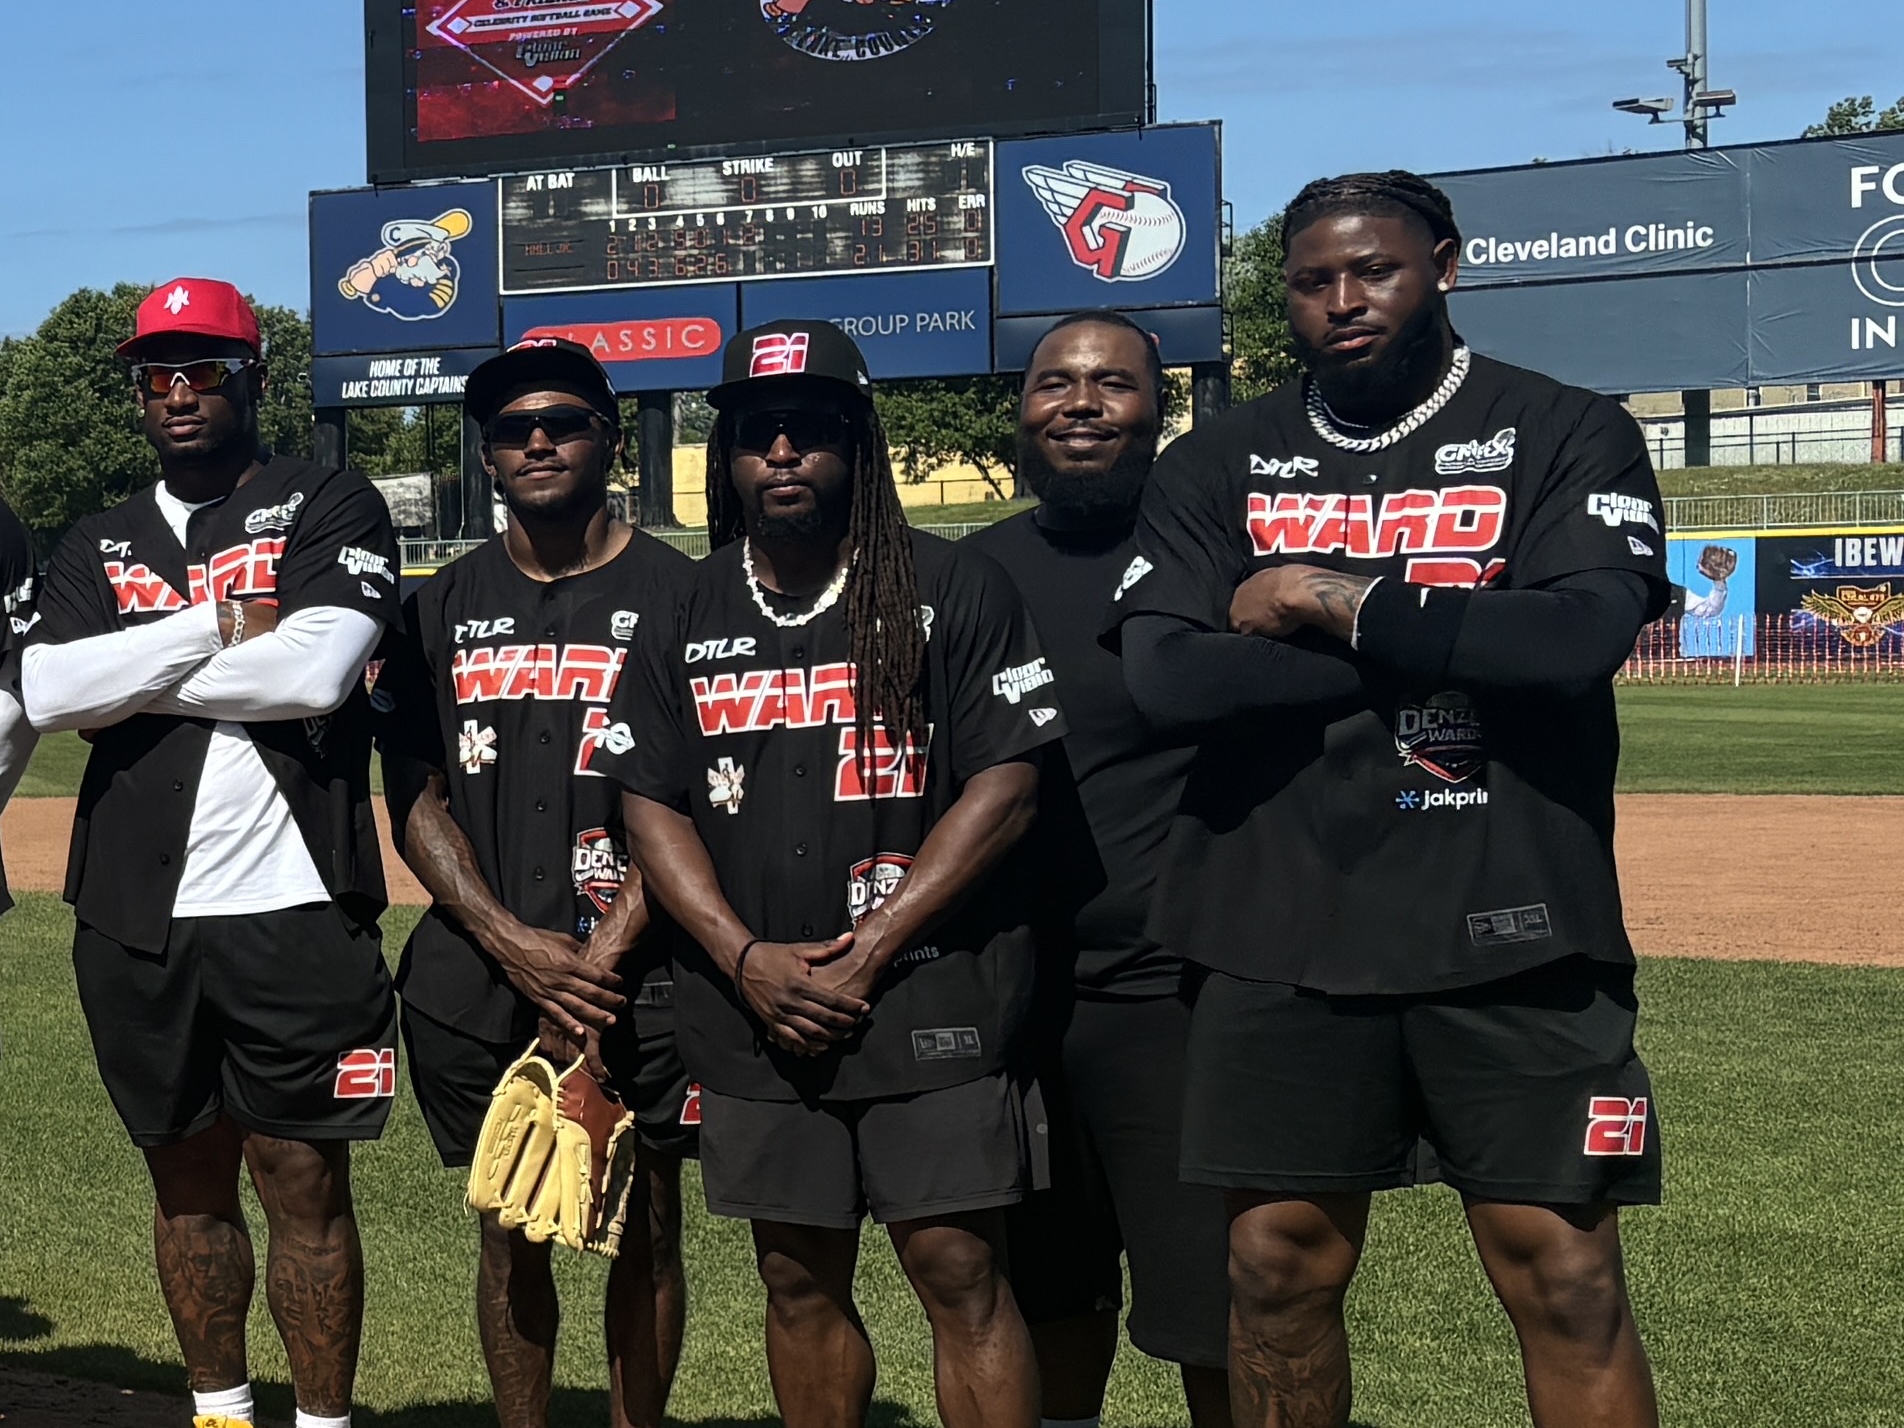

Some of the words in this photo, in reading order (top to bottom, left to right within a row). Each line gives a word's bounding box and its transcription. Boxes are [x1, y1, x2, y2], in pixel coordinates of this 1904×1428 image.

[951, 141, 976, 157] H/E
[526, 175, 544, 191] AT
[547, 172, 576, 189] BAT
[632, 165, 671, 183] BALL
[723, 157, 774, 176] STRIKE
[832, 150, 864, 168] OUT
[644, 184, 659, 209] 0
[742, 176, 757, 202] 0
[840, 168, 856, 195] 0
[609, 220, 616, 232] 1
[628, 218, 637, 231] 2
[648, 217, 657, 230] 3
[675, 215, 684, 227] 4
[696, 213, 704, 226] 5
[716, 212, 724, 225] 6
[745, 210, 753, 223] 7
[766, 209, 774, 222] 8
[786, 207, 795, 220] 9
[811, 204, 827, 218] 10
[849, 201, 886, 216] RUNS
[907, 197, 937, 212] HITS
[958, 194, 986, 209] ERR
[1465, 230, 1618, 267] Cleveland
[1624, 221, 1716, 253] Clinic
[607, 260, 618, 279] 0
[627, 258, 639, 276] 4
[915, 309, 977, 333] PARK
[1850, 315, 1896, 350] IN
[369, 360, 401, 378] HOME
[403, 359, 419, 376] OF
[420, 356, 441, 374] THE
[749, 332, 810, 378] 21
[341, 381, 369, 399] LAKE
[370, 377, 414, 397] COUNTY
[415, 375, 470, 396] CAPTAINS
[1247, 452, 1320, 479] DTLR
[1245, 484, 1509, 560] WARD
[1834, 536, 1904, 567] IBEW
[685, 635, 757, 664] DTLR
[452, 644, 628, 704] WAR
[689, 661, 860, 736] WAR
[1421, 787, 1489, 811] jakpri
[333, 1048, 396, 1099] 21
[1583, 1096, 1648, 1157] 21
